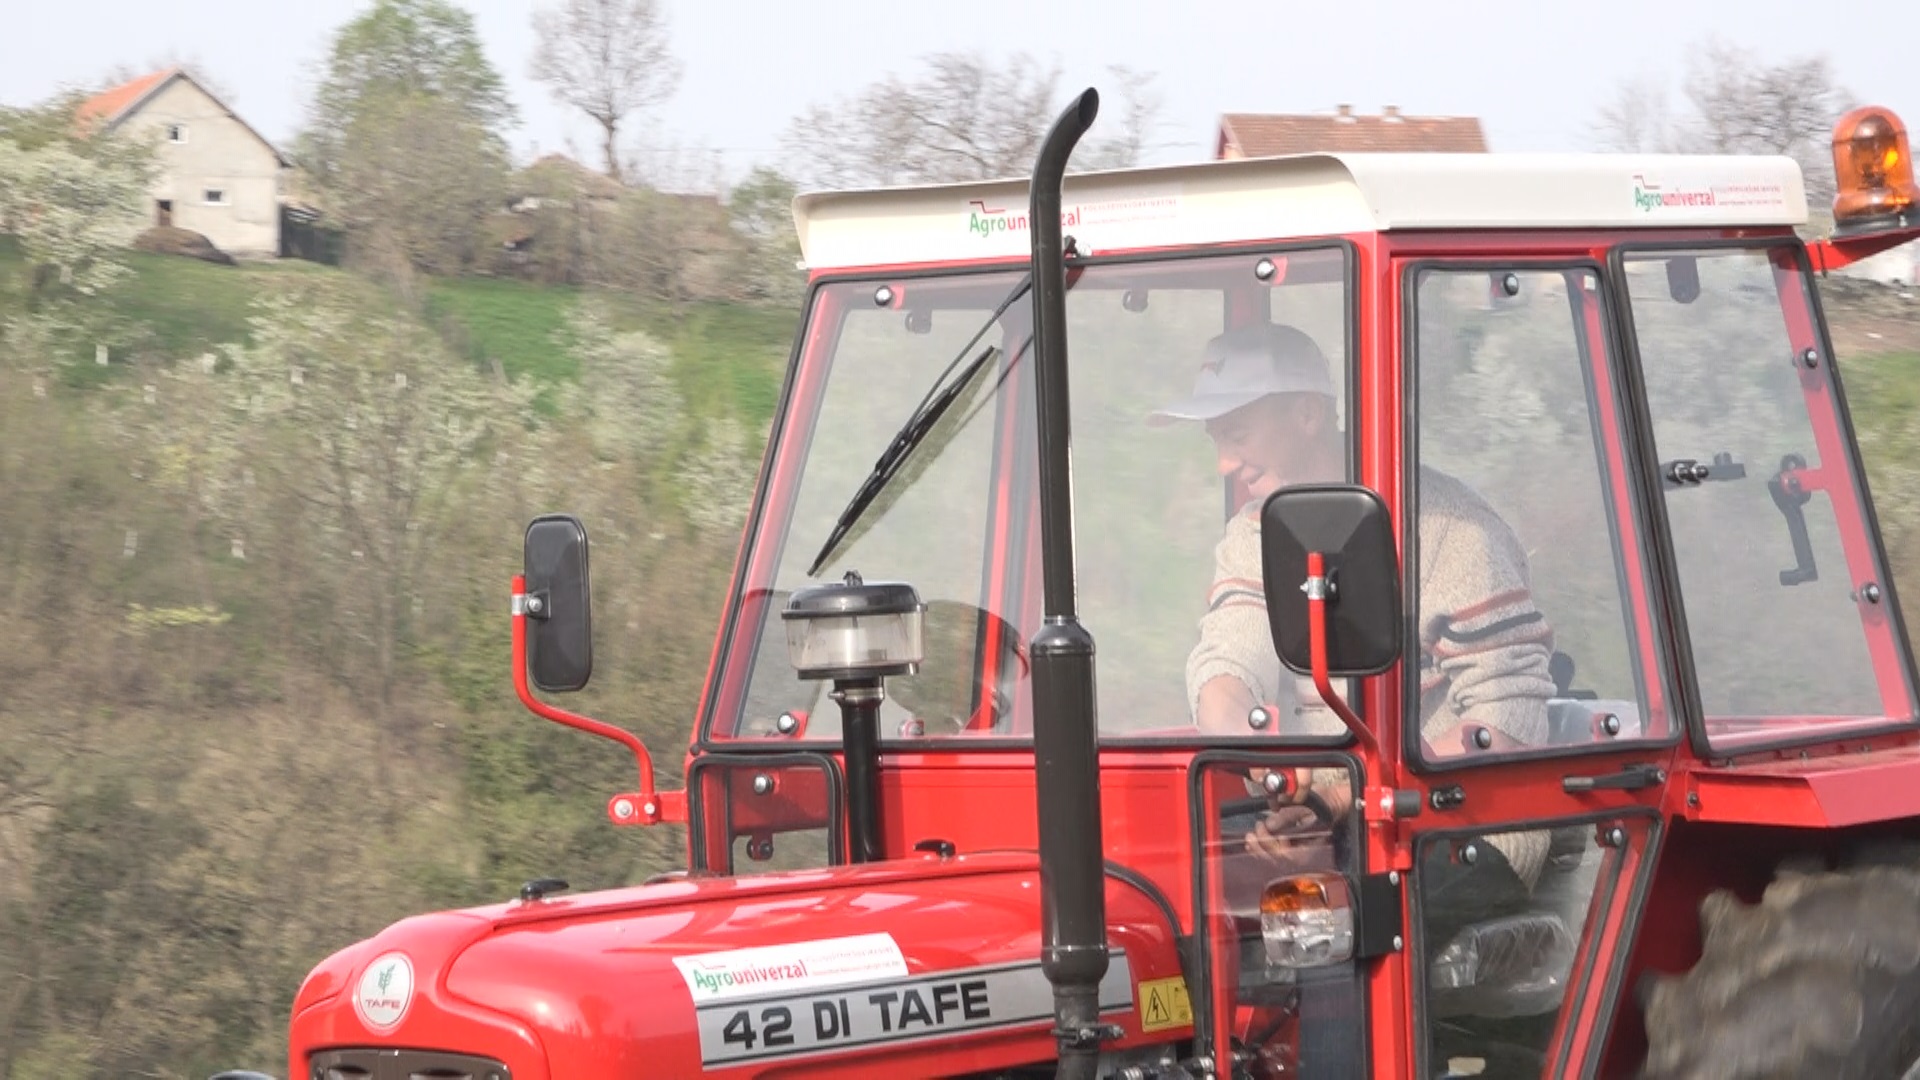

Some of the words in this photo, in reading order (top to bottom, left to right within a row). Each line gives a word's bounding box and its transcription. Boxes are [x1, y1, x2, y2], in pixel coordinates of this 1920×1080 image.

[1634, 187, 1715, 212] Agrouniverzal
[693, 959, 808, 994] Agrouniverzal
[365, 999, 401, 1009] TAFE
[723, 1006, 795, 1050] 42
[812, 998, 851, 1042] DI
[868, 980, 991, 1032] TAFE
